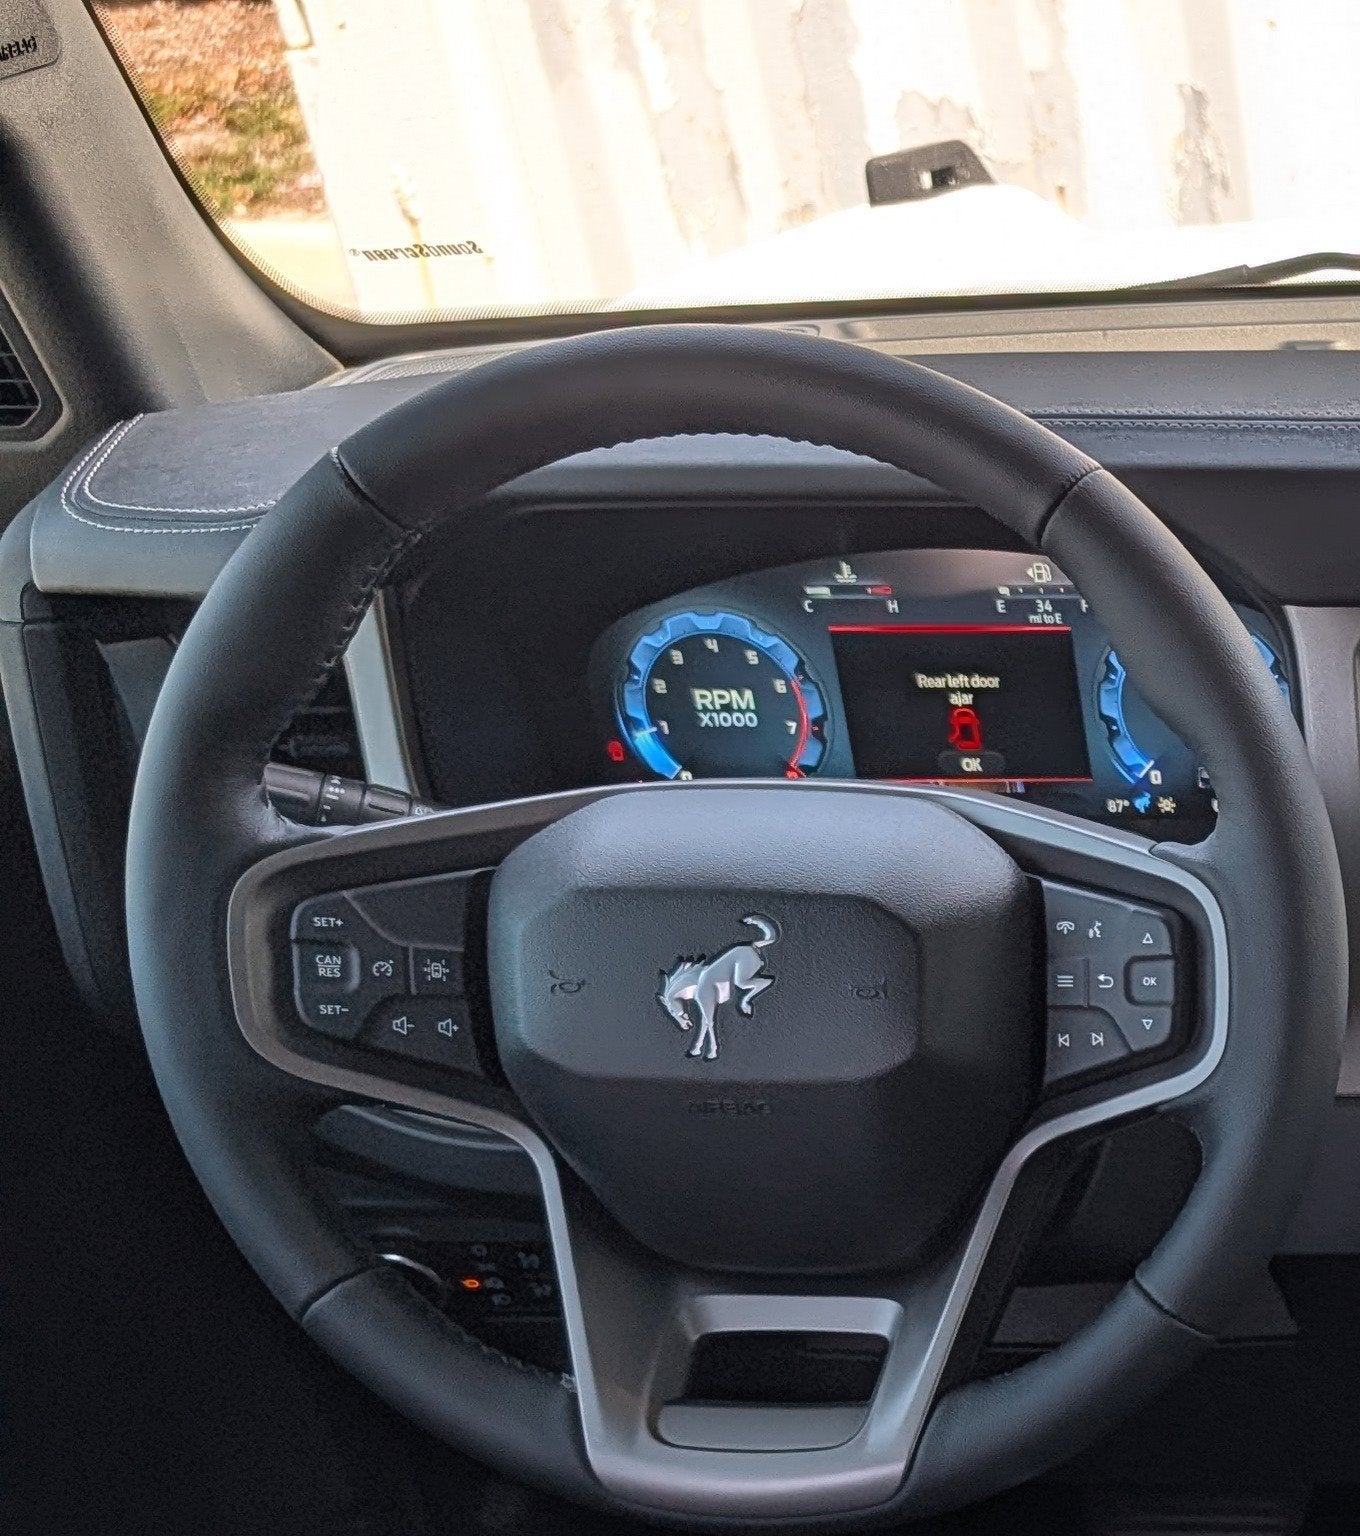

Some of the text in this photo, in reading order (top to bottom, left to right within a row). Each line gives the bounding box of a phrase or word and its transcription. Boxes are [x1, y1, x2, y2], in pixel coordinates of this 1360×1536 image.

[804, 601, 814, 613] C
[888, 601, 899, 614] H
[996, 600, 1006, 614] E
[1035, 599, 1053, 613] 34
[704, 638, 719, 653] 4
[670, 650, 684, 665] 3
[746, 650, 759, 665] 5
[653, 678, 667, 694] 2
[773, 678, 788, 694] 6
[914, 672, 1000, 689] Rear left door
[693, 688, 756, 710] RPM
[949, 691, 974, 707] ajar
[699, 712, 758, 728] X1000
[961, 756, 983, 772] OK
[315, 954, 342, 965] CAN
[318, 967, 341, 978] RES
[1143, 977, 1157, 986] OK
